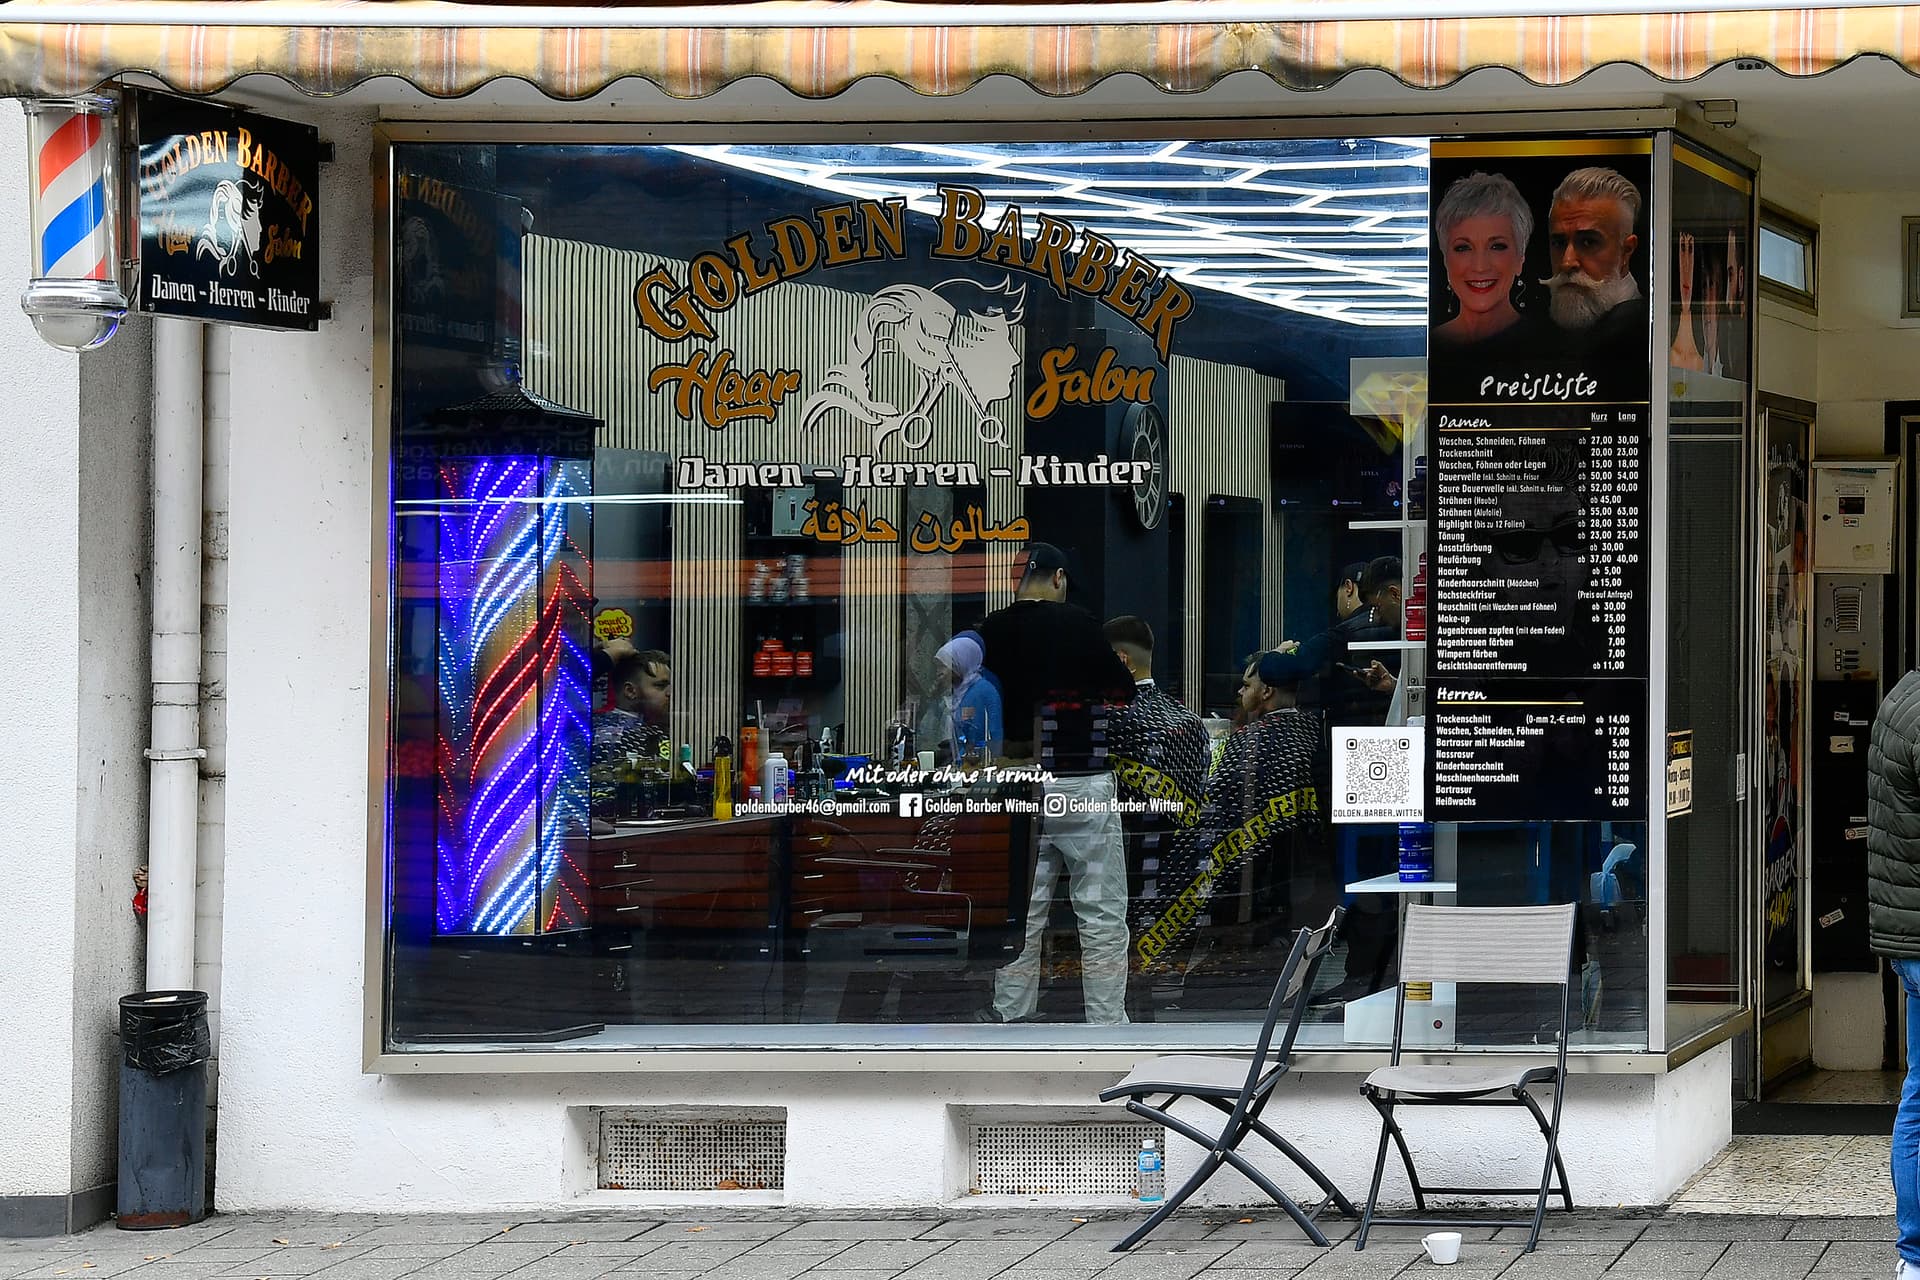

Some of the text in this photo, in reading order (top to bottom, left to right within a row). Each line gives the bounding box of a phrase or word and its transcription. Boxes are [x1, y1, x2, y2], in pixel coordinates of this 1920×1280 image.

[144, 130, 229, 201] GOLDEN
[236, 126, 313, 238] BARBER
[264, 223, 302, 264] Salon
[633, 195, 908, 343] GOLDEN
[930, 182, 1195, 366] BARBER
[151, 273, 311, 315] Damen Herren Kinder
[648, 344, 1157, 429] Haar Salon
[1481, 373, 1597, 400] Preisliste
[1439, 415, 1491, 427] Damen
[1591, 412, 1636, 422] Kurz Lang
[1439, 437, 1473, 446] Waschen,
[1476, 437, 1516, 445] Schneiden,
[1519, 437, 1545, 445] Föhnen
[1591, 436, 1612, 445] 27,00
[1618, 436, 1638, 444] 30,00
[1439, 448, 1638, 457] Trockenschnitt 20,00 23,00
[1439, 461, 1473, 469] Waschen,
[1476, 461, 1502, 469] Föhnen
[1525, 460, 1546, 470] Legen
[1592, 460, 1612, 468] 15,00
[1618, 459, 1638, 468] 18,00
[677, 455, 802, 490] Damen
[841, 454, 981, 488] Herren
[1016, 453, 1155, 488] Kinder
[1439, 473, 1481, 481] Dauerwelle
[1591, 472, 1612, 480] 50,00
[1618, 471, 1638, 480] 54,00
[1439, 484, 1460, 493] Saure
[1463, 484, 1504, 492] Dauerwelle
[1591, 484, 1612, 492] 52,00
[1617, 483, 1637, 492] 60,00
[1439, 496, 1472, 504] Strähnen
[1600, 495, 1621, 504] 45,00
[1439, 508, 1471, 516] Strähnen
[1591, 507, 1612, 516] 55,00
[1617, 507, 1638, 516] 63,00
[800, 498, 1033, 554] صالون حلاقة
[1439, 520, 1472, 530] Highlight
[1591, 519, 1612, 528] 28,00
[1617, 519, 1638, 527] 33,00
[1439, 532, 1464, 542] Tönung
[1591, 531, 1611, 540] 23,00
[1617, 531, 1638, 539] 25,00
[1438, 543, 1492, 553] Ansatzfärbung
[1602, 543, 1623, 552] 30,00
[1439, 555, 1481, 565] Neufärbung
[1590, 555, 1611, 563] 37,00
[1617, 554, 1638, 563] 40,00
[1438, 567, 1468, 575] Haarkur
[1605, 566, 1621, 575] 5,00
[1438, 578, 1504, 587] Kinderhaarschnitt
[1601, 578, 1621, 587] 15,00
[1438, 590, 1496, 599] Hochsteckfrisur
[1438, 602, 1477, 611] Neuschnitt
[1604, 602, 1625, 611] 30,00
[1438, 614, 1470, 624] Make-up
[1604, 614, 1625, 623] 25,00
[1438, 626, 1486, 636] Augenbrauen
[1489, 626, 1513, 636] zupfen
[1608, 626, 1625, 634] 6,00
[1437, 637, 1625, 648] Augenbrauen färben 7,00
[1437, 649, 1625, 660] Wimpern färben 7,00
[1437, 661, 1527, 671] Gesichtshaarentfernung
[1604, 661, 1624, 670] 11,00
[1437, 687, 1487, 700] Herren
[1437, 715, 1491, 723] Trockenschnitt
[1609, 715, 1629, 724] 14,00
[1436, 726, 1471, 735] Waschen,
[1474, 726, 1514, 736] Schneiden,
[1517, 726, 1543, 735] Föhnen
[1609, 727, 1629, 736] 17,00
[1436, 738, 1473, 747] Bartrasur
[1490, 738, 1525, 747] Maschine
[1613, 739, 1629, 748] 5,00
[1436, 750, 1629, 759] Nassrasur 15,00
[1436, 762, 1629, 771] Kinderhaarschnitt 10,00
[846, 763, 1059, 785] Mit oder ohne Termin
[1436, 773, 1629, 783] Maschinenhaarschnitt 10,00
[1436, 785, 1472, 794] Bartrasur
[1608, 786, 1629, 795] 12,00
[925, 799, 1040, 815] Golden Barber Witten
[1069, 799, 1184, 815] Golden Barber Witten
[1436, 797, 1629, 807] Heißwachs 6,00
[734, 798, 891, 817] goldenbarber46@gmail.com
